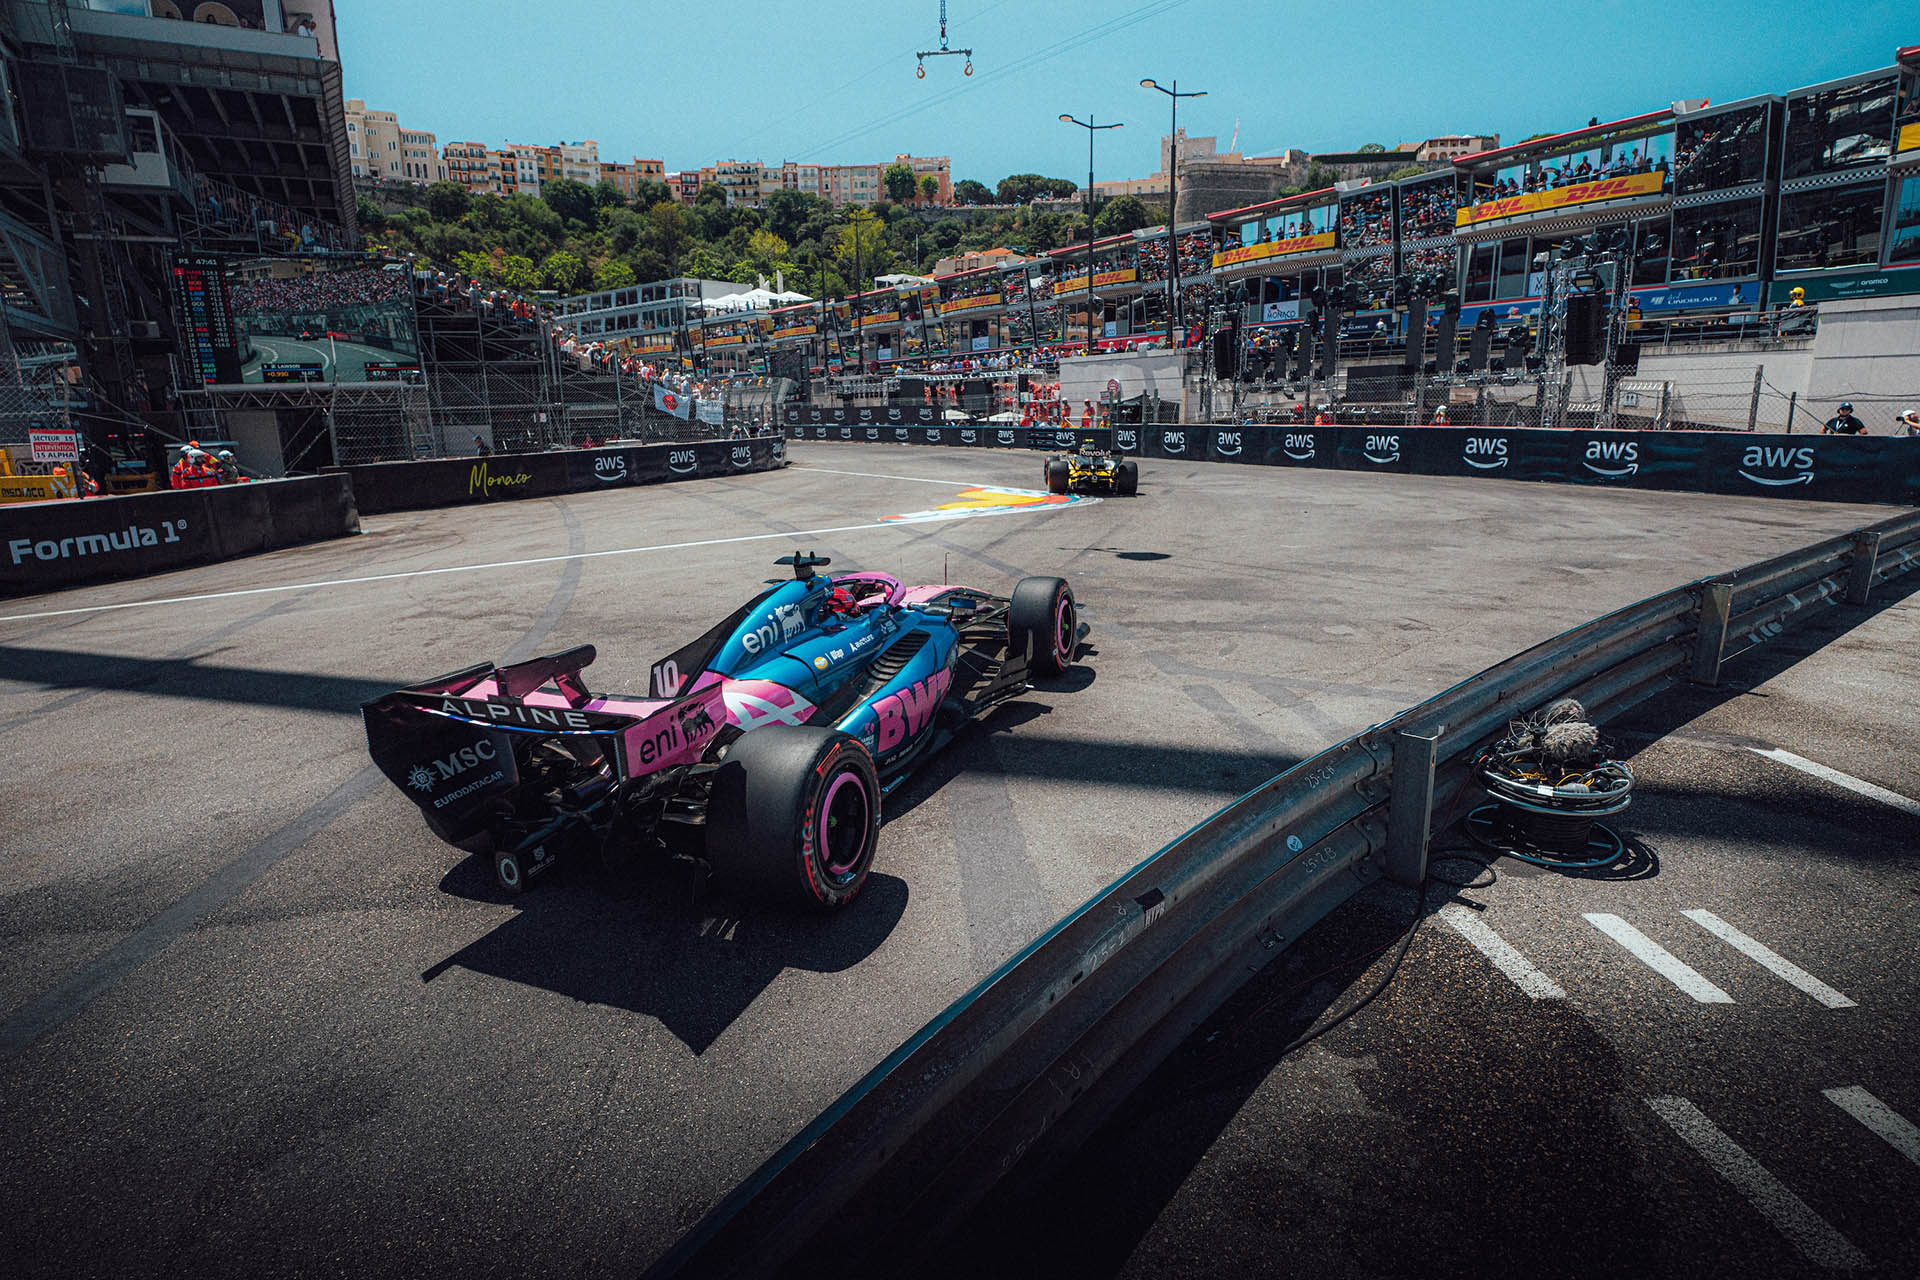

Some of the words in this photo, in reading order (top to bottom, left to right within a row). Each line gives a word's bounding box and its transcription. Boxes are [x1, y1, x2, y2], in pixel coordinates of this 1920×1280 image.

[1565, 179, 1632, 202] DHL
[1475, 198, 1525, 221] DHL
[1278, 237, 1315, 253] DHL
[1218, 432, 1241, 445] aws
[1284, 433, 1314, 448] aws
[1365, 435, 1399, 451] aws
[1465, 437, 1508, 456] aws
[1585, 440, 1638, 460] aws
[1080, 449, 1112, 458] Revolut
[1741, 445, 1814, 469] aws
[469, 462, 532, 496] Monaco
[8, 525, 159, 565] Formula
[743, 614, 779, 654] eni
[654, 660, 680, 698] 10
[442, 698, 591, 729] ALPINE
[640, 717, 677, 769] eni
[433, 739, 496, 781] MSC
[433, 770, 506, 809] EURODATACAR
